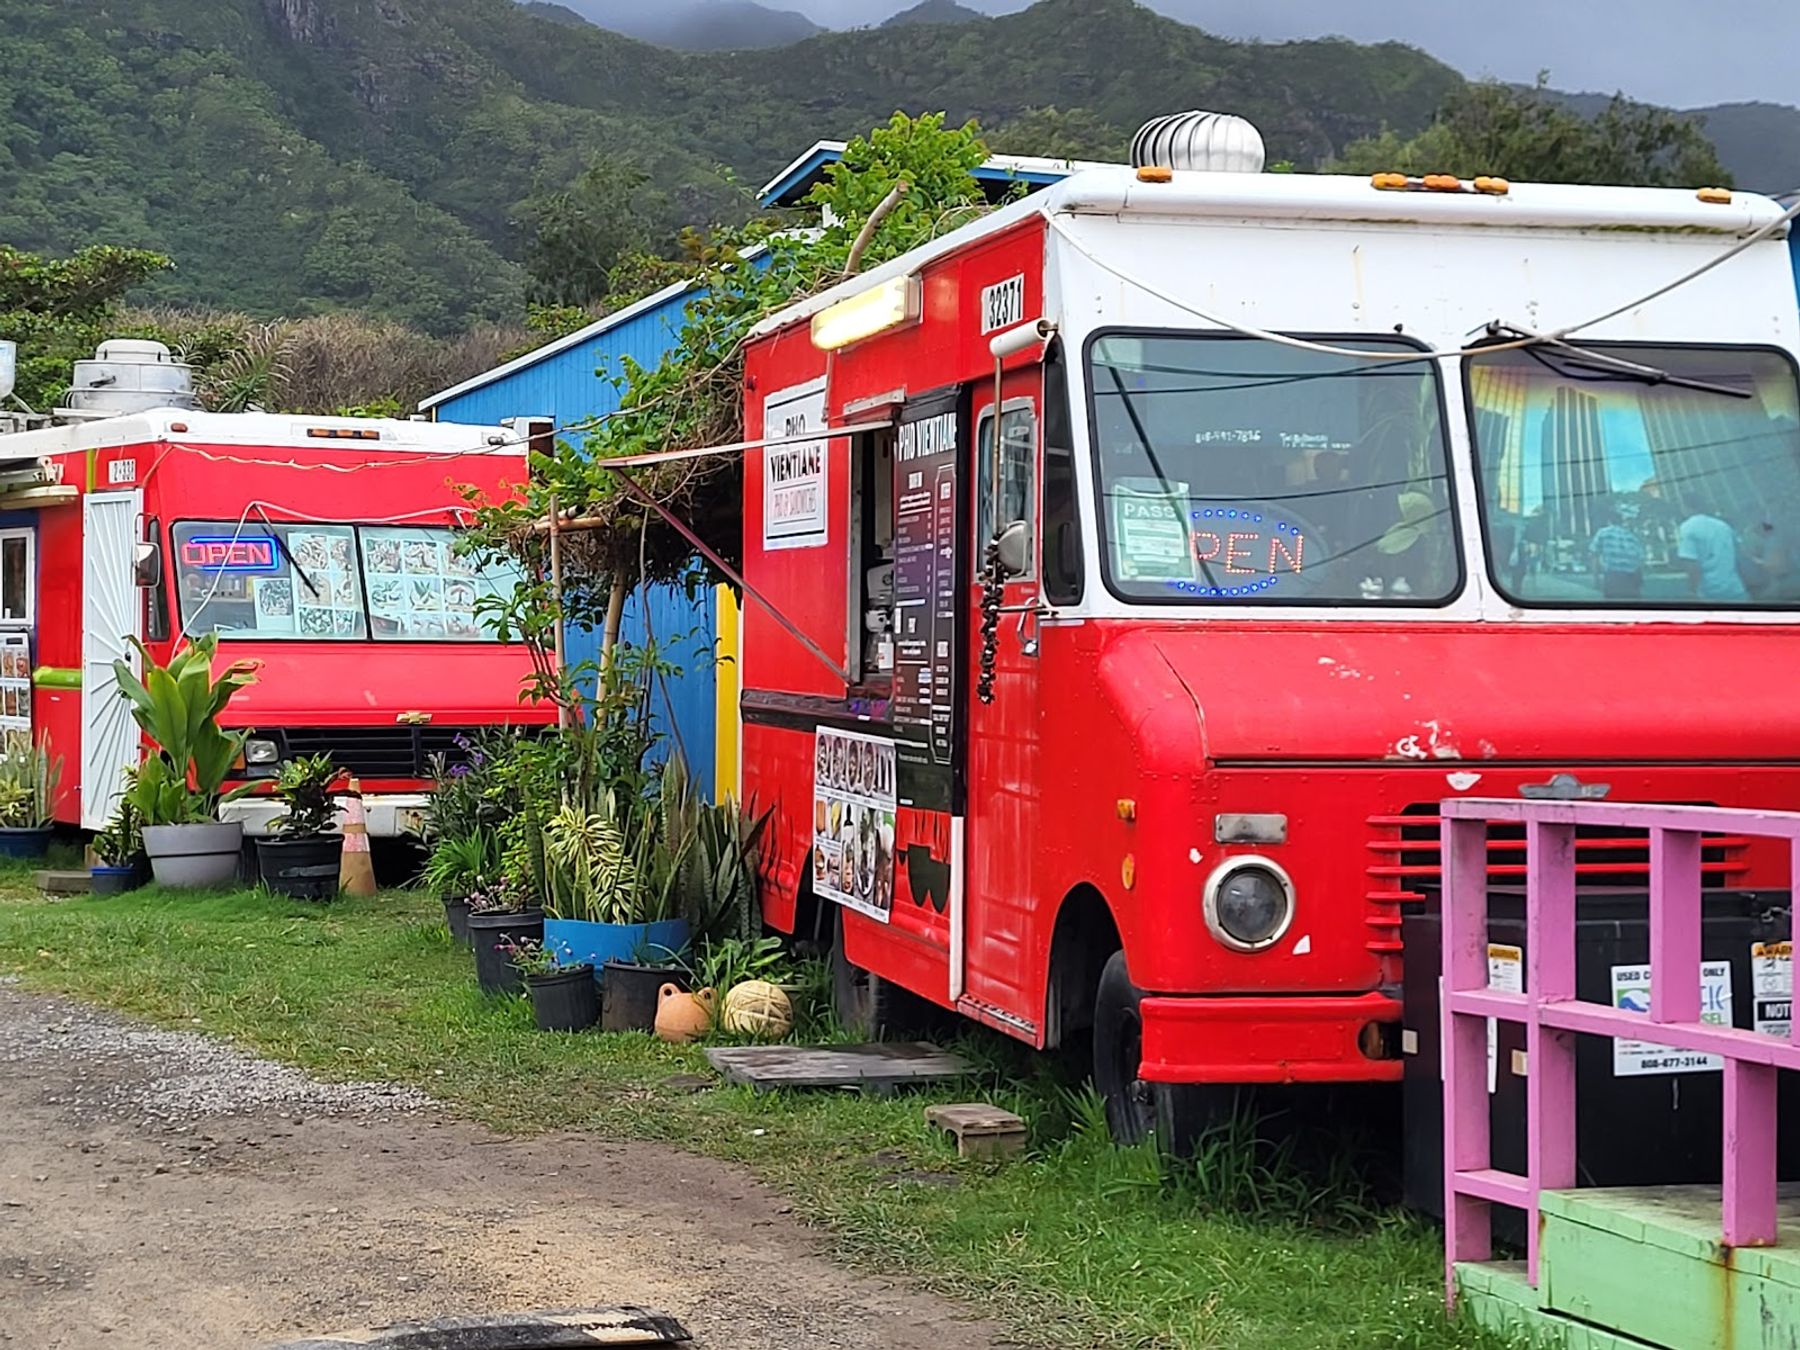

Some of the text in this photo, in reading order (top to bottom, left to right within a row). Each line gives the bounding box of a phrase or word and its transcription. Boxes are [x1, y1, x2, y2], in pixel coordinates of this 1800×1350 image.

[990, 277, 1022, 329] 32371
[898, 421, 916, 462] PHO
[770, 445, 821, 483] VIENTIANE
[1123, 501, 1177, 519] PASS
[181, 542, 272, 566] OPEN
[1189, 530, 1305, 575] PEN
[1702, 967, 1726, 977] ONLY
